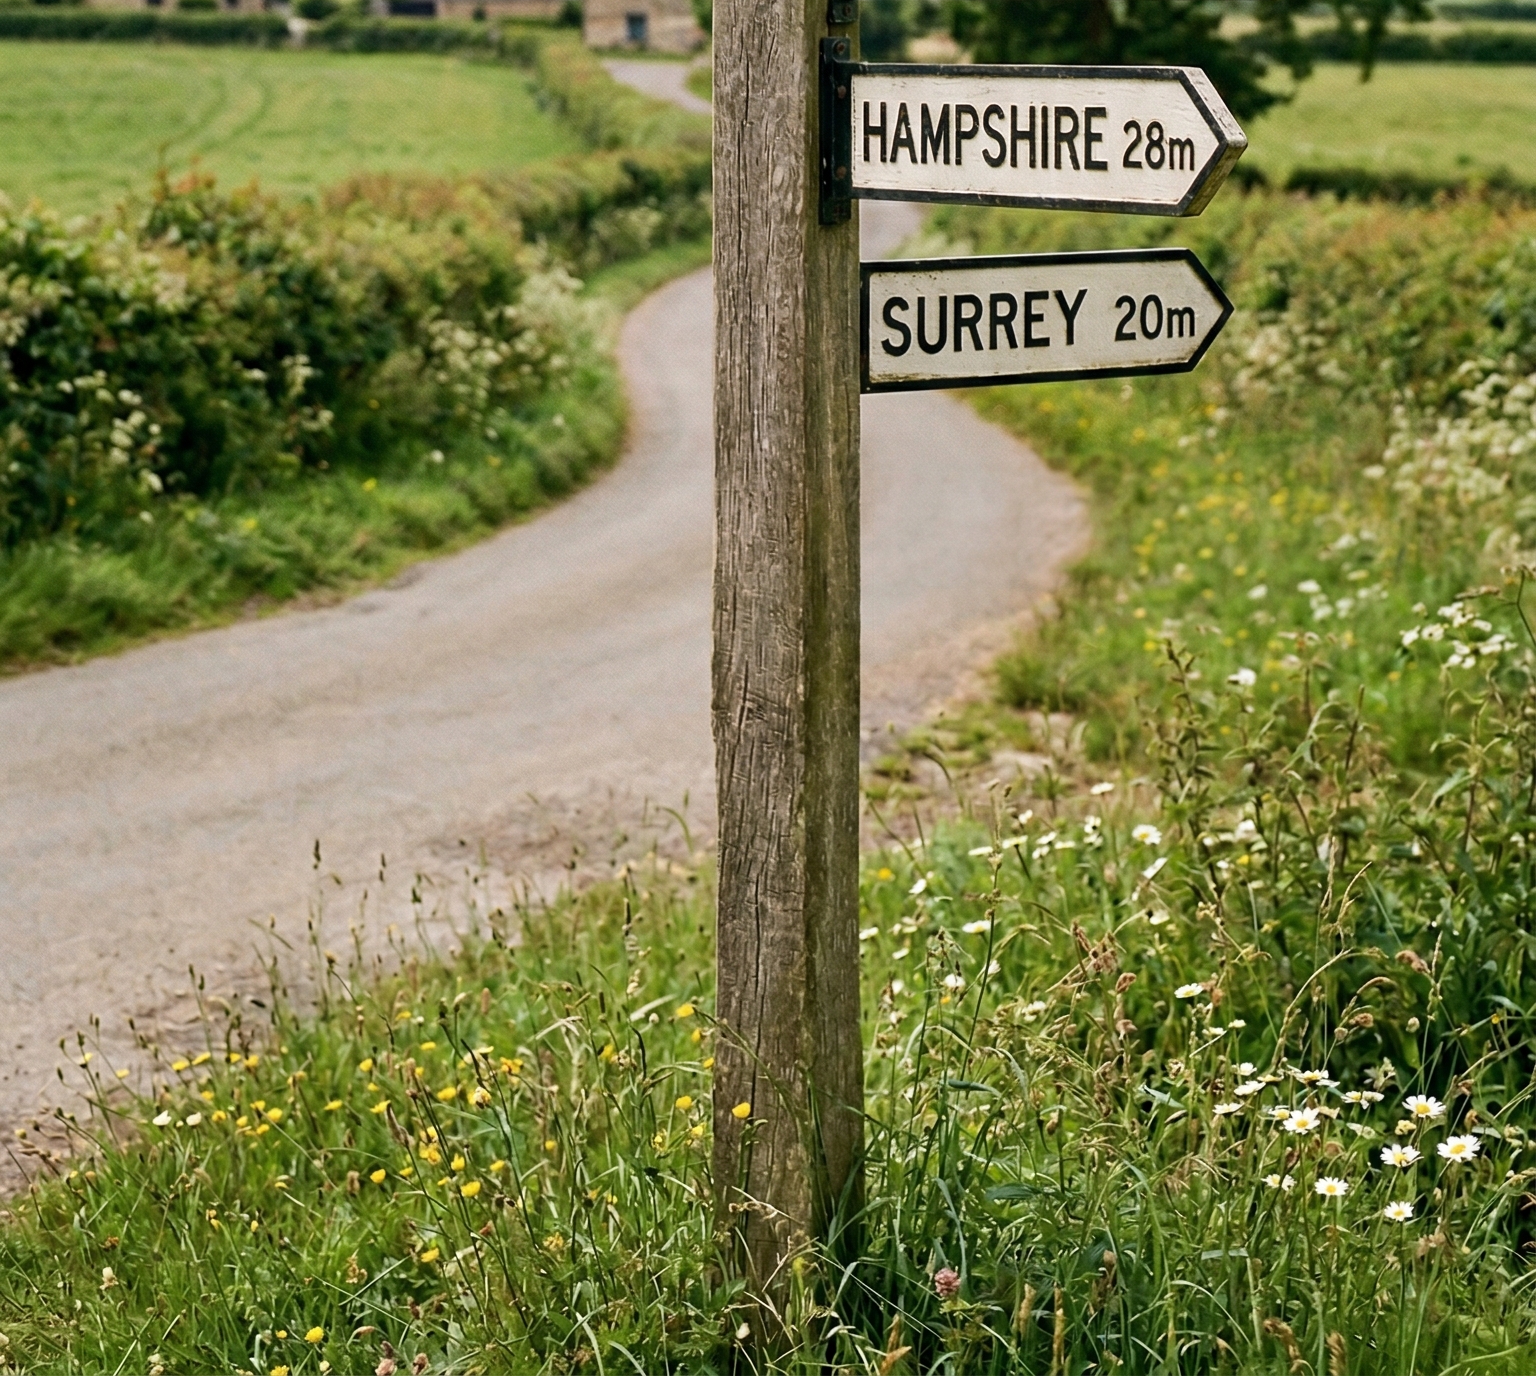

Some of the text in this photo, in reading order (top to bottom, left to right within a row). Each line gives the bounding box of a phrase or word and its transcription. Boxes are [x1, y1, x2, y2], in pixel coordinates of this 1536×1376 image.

[862, 100, 1196, 172] HAMPSHIRE 28m
[880, 288, 1197, 358] SURREY 20m
